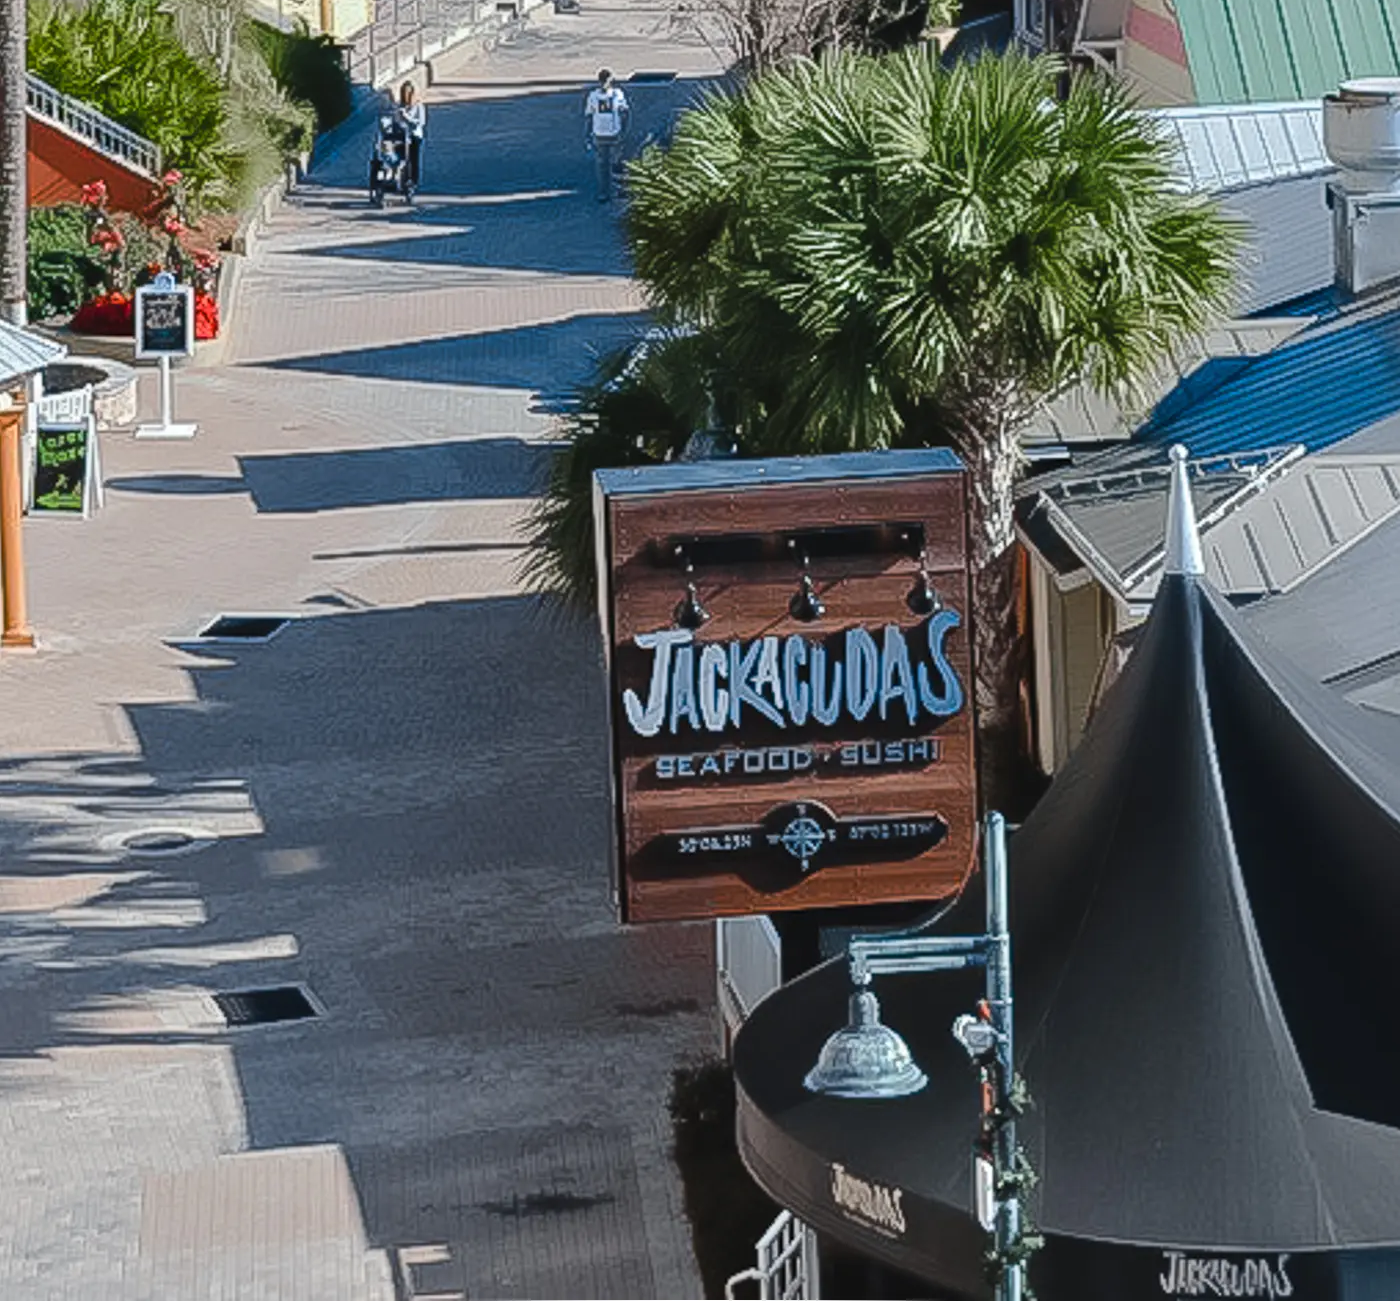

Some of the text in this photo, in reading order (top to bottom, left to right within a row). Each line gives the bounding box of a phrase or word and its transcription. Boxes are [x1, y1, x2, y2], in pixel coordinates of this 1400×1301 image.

[623, 610, 965, 736] JACKACUDAS
[655, 740, 939, 778] SEAFOOD SUSHI
